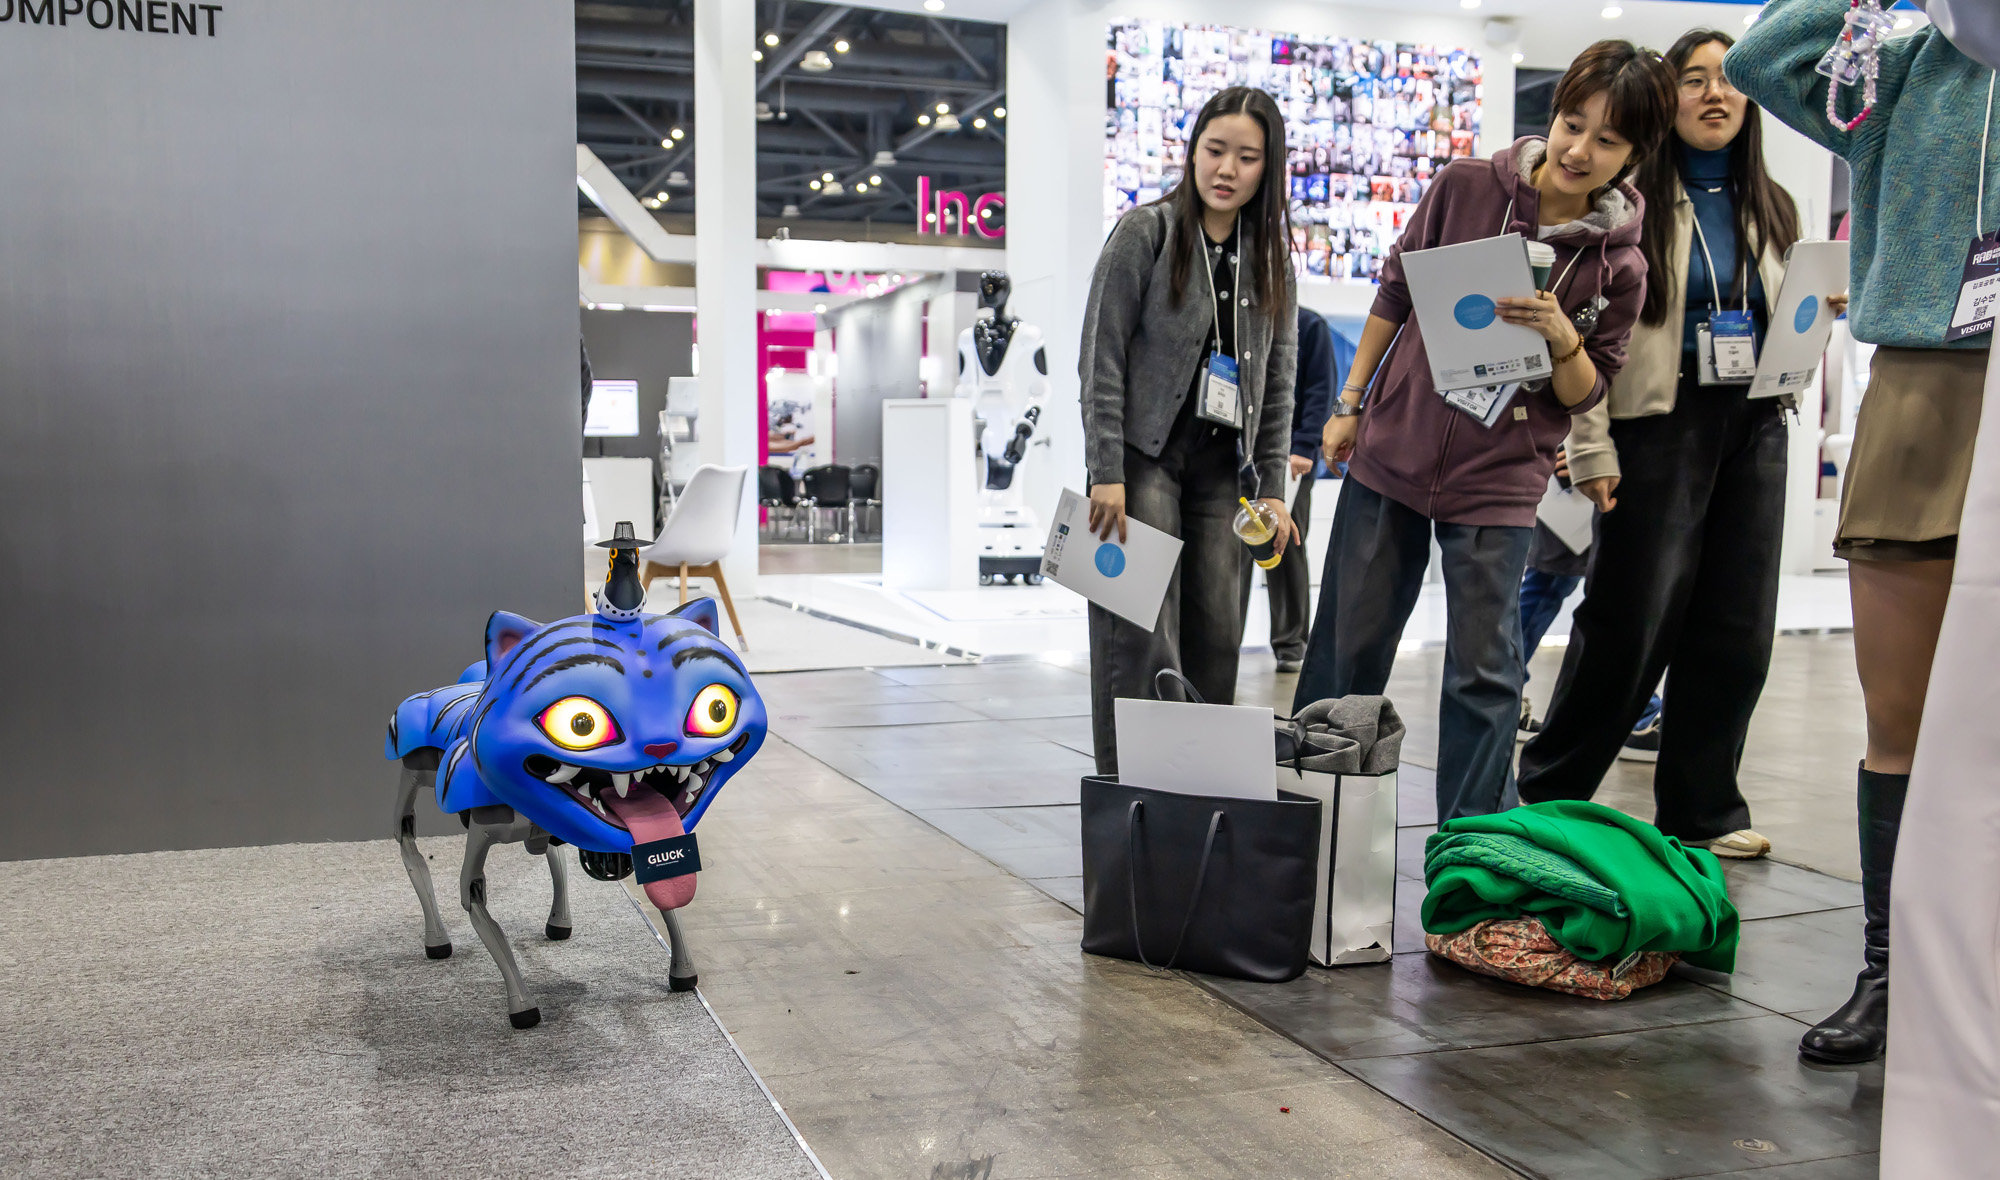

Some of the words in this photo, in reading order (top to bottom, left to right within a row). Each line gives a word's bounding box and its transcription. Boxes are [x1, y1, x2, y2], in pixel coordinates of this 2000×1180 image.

[1960, 320, 1993, 335] VISITOR
[1457, 397, 1478, 411] VISITOR
[647, 848, 685, 865] GLUCK
